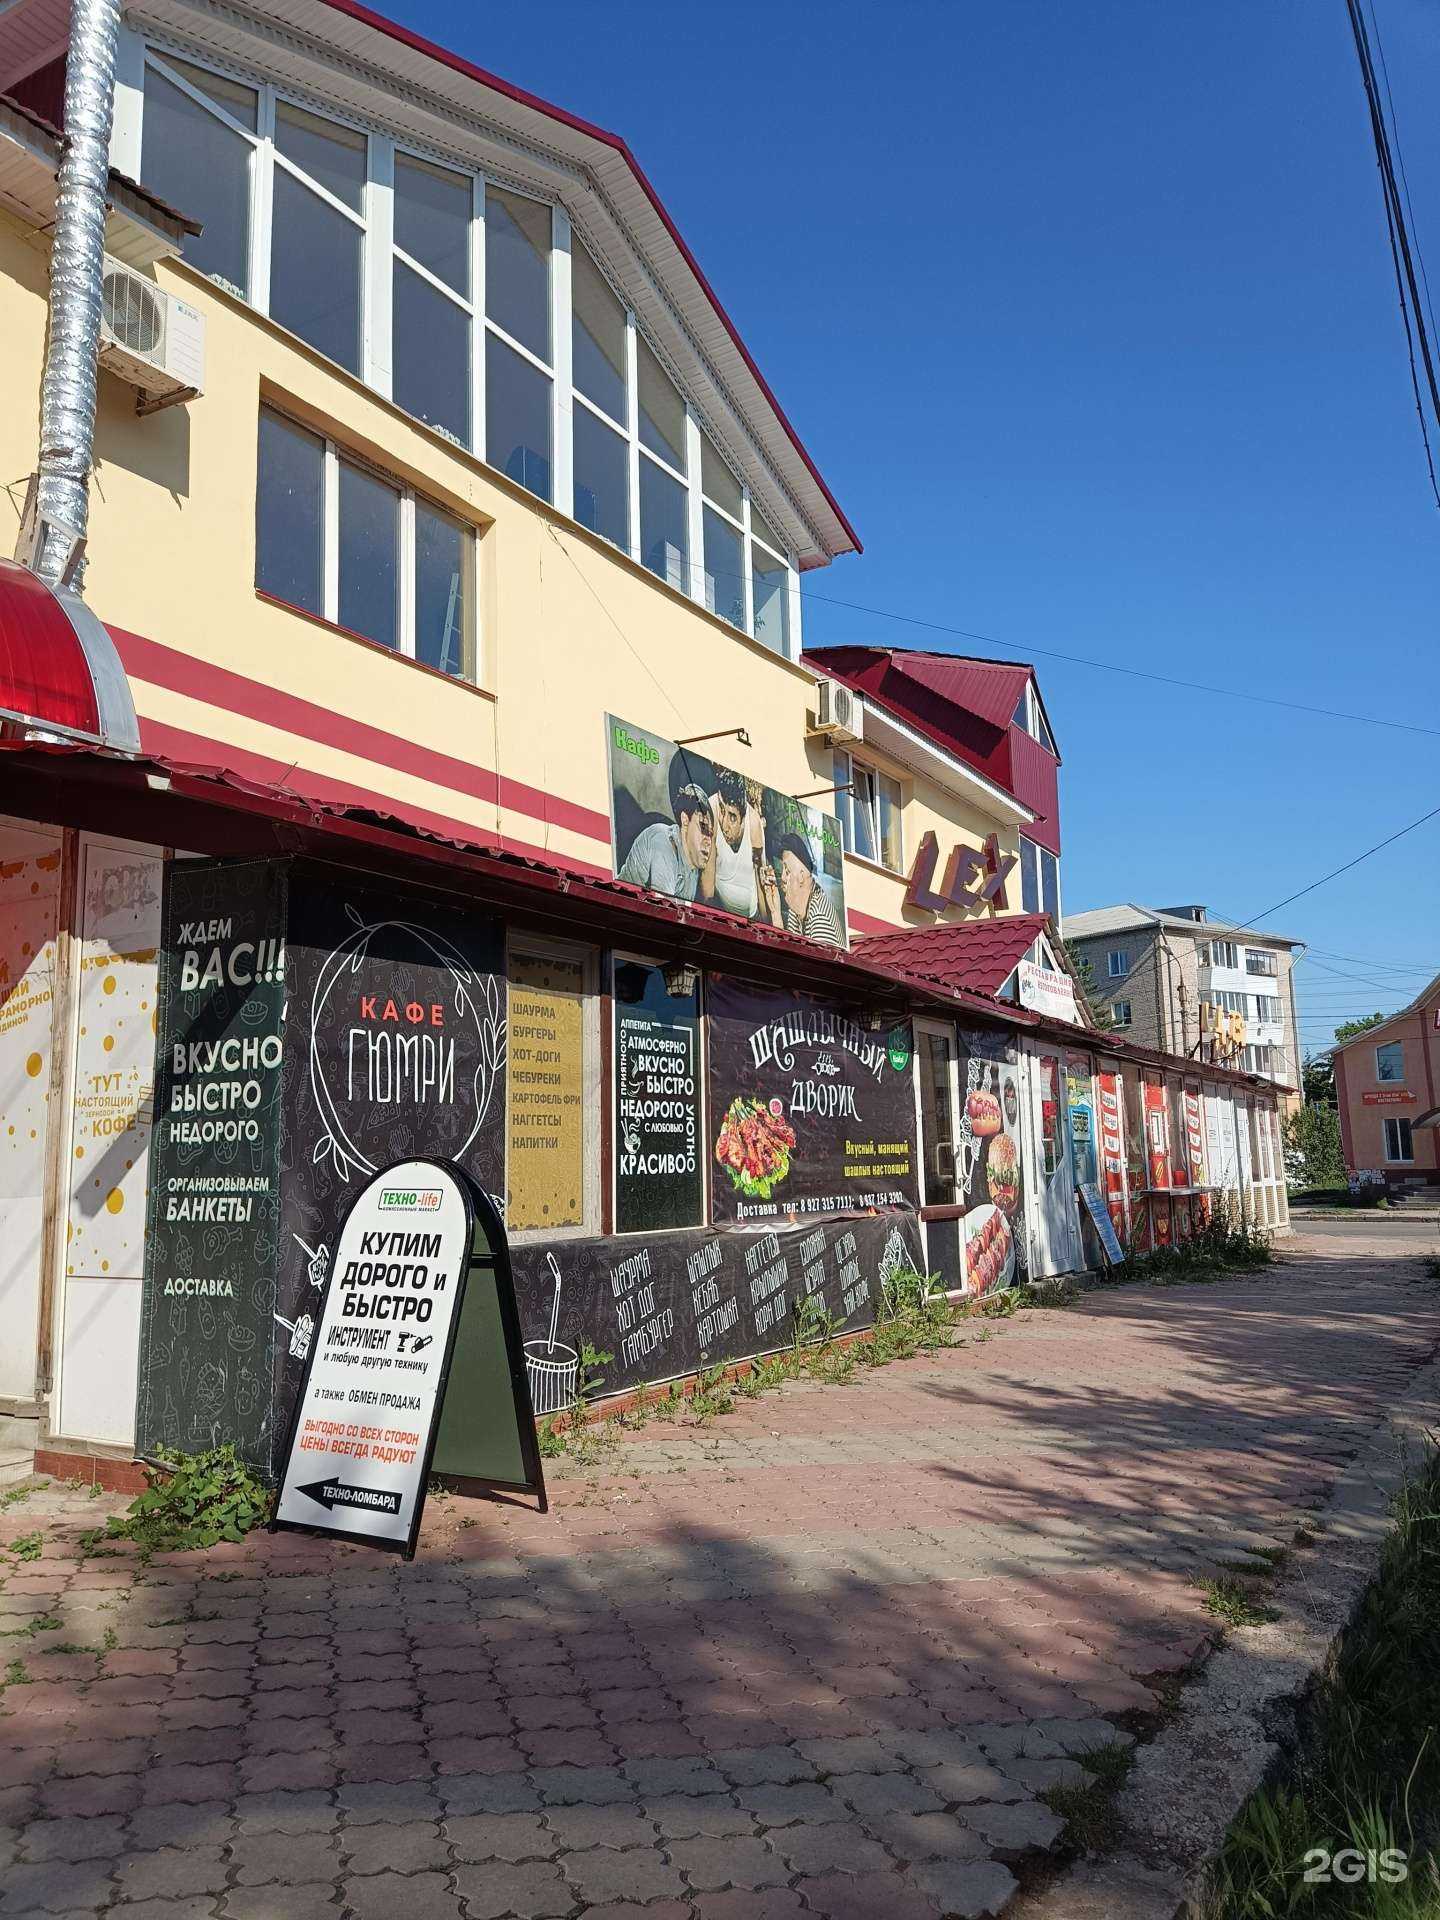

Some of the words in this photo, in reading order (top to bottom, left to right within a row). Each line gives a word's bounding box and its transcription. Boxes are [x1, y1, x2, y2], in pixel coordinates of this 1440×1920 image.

[177, 917, 232, 946] ЖДЕМ
[180, 937, 286, 992] ВАС!!!
[360, 996, 445, 1026] КАФЕ
[512, 1002, 556, 1020] ШАУРМА
[512, 1025, 556, 1041] БУРГЕРЫ
[620, 1018, 652, 1031] АППЕТИТА
[173, 1035, 283, 1075] ВКУСНО
[512, 1048, 561, 1064] ХОТ-ДОГИ
[628, 1036, 686, 1054] АТМОСФЕРНО
[748, 1009, 886, 1084] ШАШЛЫЧНЫЙ
[348, 1028, 455, 1105] ГЮМРИ
[638, 1054, 684, 1075] ВКУСНО
[92, 1072, 122, 1093] ТУТ
[512, 1070, 561, 1085] ЧЕБУРЕКИ
[646, 1075, 694, 1096] БЫСТРО
[75, 1095, 134, 1108] НАСТОЯЩИЙ
[170, 1079, 262, 1113] БЫСТРО
[512, 1092, 562, 1105] КАРТОФЕЛЬ
[563, 1094, 581, 1106] ФРИ
[790, 1078, 863, 1122] ДВОРИК
[512, 1113, 562, 1127] НАГГЕТСЫ
[620, 1099, 684, 1120] НЕДОРОГО
[92, 1114, 136, 1137] КОФЕ
[170, 1119, 259, 1145] НЕДОРОГО
[644, 1123, 650, 1133] С
[651, 1122, 684, 1133] ЛЮБОВЬЮ
[685, 1104, 696, 1172] УЮТНО
[512, 1136, 559, 1149] НАПИТКИ
[845, 1139, 877, 1159] Вкусный,
[620, 1153, 687, 1175] КРАСИВО
[872, 1160, 909, 1176] настоящий
[167, 1177, 270, 1192] ОРГАНИЗОВЫВАЕМ
[166, 1197, 253, 1222] БАНКЕТЫ
[736, 1202, 778, 1221] Доставка
[782, 1204, 799, 1215] тел:
[800, 1200, 806, 1212] 8
[807, 1198, 820, 1212] 927
[822, 1197, 835, 1211] 315
[858, 1194, 864, 1208] 8
[876, 1192, 888, 1205] 154
[359, 1231, 443, 1258] КУПИМ
[744, 1232, 781, 1276] НАГГЕТСЫ
[610, 1248, 652, 1298] ШАУРМА
[686, 1238, 723, 1284] ШАШЛЫК
[164, 1277, 234, 1297] ДОСТАВКА
[340, 1262, 428, 1290] ДОРОГО
[433, 1273, 447, 1291] и
[749, 1257, 789, 1306] КРЫЛЫШКИ
[342, 1292, 433, 1323] БЫСТРО
[616, 1295, 636, 1333] ХОТ
[637, 1281, 656, 1319] ДОГ
[692, 1276, 720, 1317] КЕБАБ
[697, 1296, 740, 1349] КАРТОШКА
[327, 1325, 392, 1350] ИНСТРУМЕНТ
[621, 1308, 674, 1369] ГАМБУРГЕР
[323, 1352, 329, 1361] и
[330, 1352, 359, 1367] любую
[360, 1355, 392, 1370] другую
[394, 1359, 429, 1374] технику
[314, 1388, 320, 1398] а
[321, 1388, 345, 1401] также
[348, 1389, 379, 1406] ОБМЕН
[379, 1392, 421, 1411] ПРОДАЖА
[304, 1419, 345, 1437] ВЫГОДНО
[346, 1424, 359, 1437] СО
[360, 1426, 383, 1441] ВСЕХ
[384, 1430, 420, 1446] СТОРОН
[300, 1435, 330, 1453] ЦЕНЫ
[331, 1440, 368, 1459] ВСЕГДА
[371, 1445, 417, 1464] РАДУЮТ
[322, 1486, 396, 1510] ТЕХНО-ЛОМБАРД
